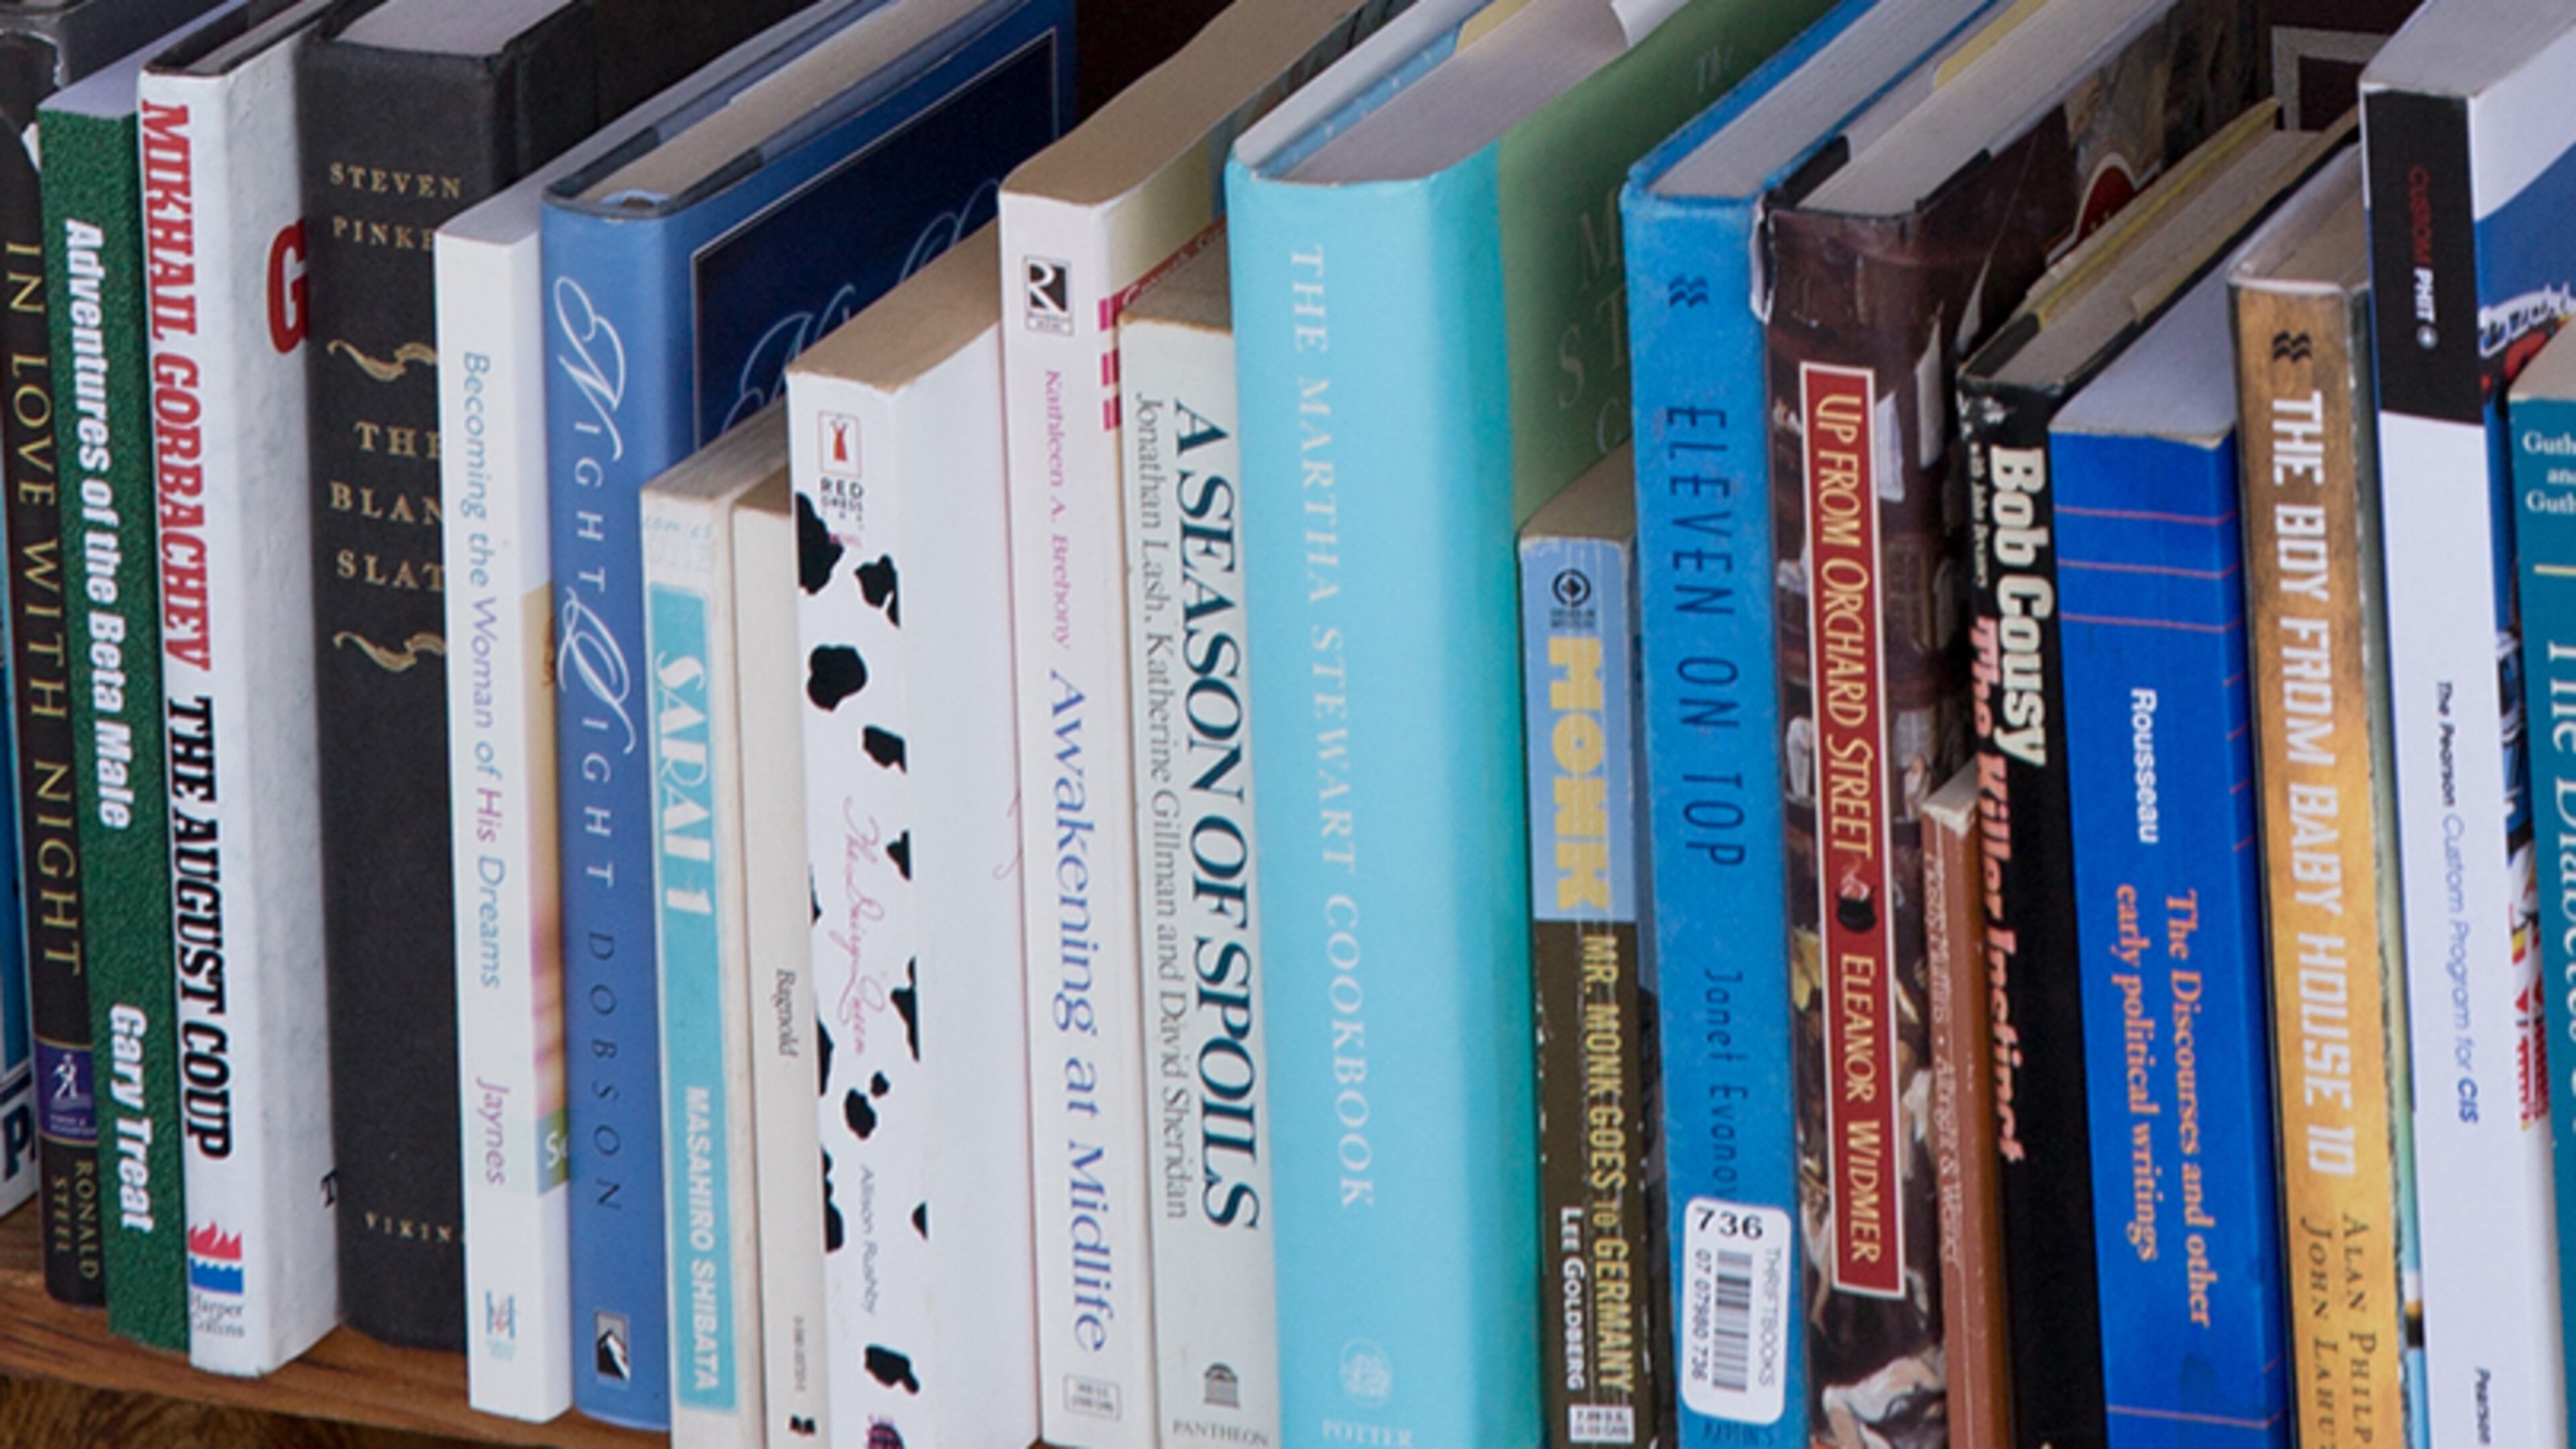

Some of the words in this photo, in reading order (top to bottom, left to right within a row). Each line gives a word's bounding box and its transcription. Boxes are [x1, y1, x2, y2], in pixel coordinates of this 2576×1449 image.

[141, 101, 197, 341] MIKHAIL
[329, 162, 462, 199] STEVEN
[2408, 165, 2434, 264] CUSTOM
[6, 241, 45, 314] IN
[1289, 242, 1328, 354] THE
[2414, 267, 2436, 323] PHIT
[64, 218, 111, 474] Adventures
[11, 354, 56, 508] LOVE
[460, 351, 491, 519] Becoming
[1044, 368, 1067, 490] Kathleen
[1134, 390, 1166, 532] Jonathan
[1174, 398, 1230, 458] A
[1815, 393, 1862, 446] UP
[2271, 389, 2324, 485] THE
[80, 476, 120, 527] of
[152, 352, 213, 672] GORBACHEV
[819, 477, 865, 498] RED
[1046, 499, 1065, 524] A.
[1296, 376, 1340, 605] MARTHA
[1666, 405, 1736, 616] ELEVEN
[1817, 449, 1862, 549] FROM
[1989, 444, 2049, 567] Bob
[83, 527, 123, 603] the
[468, 526, 497, 588] the
[1051, 535, 1073, 651] Brehony
[1140, 540, 1171, 624] Lash,
[2274, 503, 2329, 601] BOY
[21, 537, 67, 718] WITH
[88, 610, 131, 712] Beta
[472, 596, 498, 729] Woman
[1175, 471, 1244, 805] SEASON
[1821, 557, 1869, 727] ORCHARD
[1970, 615, 2000, 739] The
[1993, 574, 2054, 767] Cousy
[1144, 632, 1177, 787] Katherine
[1676, 656, 1741, 729] ON
[2280, 616, 2336, 767] FROM
[2436, 681, 2453, 716] The
[94, 720, 135, 830] Male
[168, 695, 216, 802] THE
[474, 742, 502, 781] of
[655, 651, 711, 863] SARAI
[1309, 623, 1357, 875] STEWART
[1548, 636, 1611, 910] MONK
[1825, 733, 1874, 859] STREET
[2130, 688, 2159, 844] Rousseau
[2438, 722, 2456, 806] Pearson
[34, 759, 81, 975] NIGHT
[476, 786, 503, 843] His
[842, 795, 880, 868] The
[1048, 668, 1099, 1038] Awakening
[1150, 790, 1183, 917] Gillman
[1681, 773, 1746, 867] TOP
[1976, 751, 2011, 926] Killer
[2288, 782, 2343, 916] BABY
[2443, 814, 2467, 914] Custom
[173, 808, 228, 1016] AUGUST
[477, 855, 505, 989] Dreams
[664, 888, 713, 916] 1
[1189, 814, 1249, 931] OF
[2110, 883, 2151, 969] early
[2166, 888, 2198, 961] The
[1155, 923, 1186, 982] and
[1582, 935, 1621, 994] MR.
[2445, 919, 2471, 1032] Program
[110, 1003, 148, 1110] Gary
[588, 931, 622, 1210] DOBSON
[1158, 989, 1189, 1081] David
[1324, 894, 1375, 1208] COOKBOOK
[1584, 1002, 1623, 1099] MONK
[1703, 968, 1747, 1063] Janet
[1840, 953, 1877, 1103] ELEANOR
[1986, 928, 2025, 1163] Instinct
[2110, 971, 2161, 1115] political
[2170, 969, 2202, 1155] Discourses
[2296, 930, 2353, 1110] HOUSE
[2453, 1036, 2474, 1072] for
[182, 1020, 233, 1159] COUP
[476, 1077, 511, 1186] Jaynes
[1065, 1057, 1099, 1118] at
[1193, 936, 1261, 1232] SPOILS
[2456, 1077, 2479, 1123] CIS
[115, 1117, 154, 1232] Treat
[684, 1085, 716, 1251] MASAHIRO
[1162, 1085, 1195, 1220] Sheridan
[1587, 1108, 1627, 1192] GOES
[1845, 1118, 1882, 1265] WIDMER
[2126, 1121, 2165, 1262] writings
[2181, 1162, 2216, 1230] and
[2306, 1124, 2357, 1177] 10
[75, 1159, 99, 1281] RONALD
[364, 1210, 464, 1242] VIKIN
[1068, 1138, 1115, 1352] Midlife
[1560, 1208, 1582, 1252] LEE
[1592, 1198, 1620, 1228] TO
[1693, 1248, 1712, 1276] 07
[1695, 1206, 1764, 1241] 736
[2300, 1216, 2332, 1320] JOHN
[2341, 1213, 2370, 1313] ALAN
[691, 1259, 720, 1392] SHIBATA
[1562, 1257, 1589, 1391] GOLDBERG
[1593, 1238, 1636, 1394] GERMANY
[1758, 1248, 1782, 1389] THRIFTBOOKS
[2186, 1234, 2218, 1328] other
[1690, 1344, 1709, 1382] 736
[2349, 1331, 2378, 1449] PHILP
[1171, 1417, 1271, 1448] PANTHEON
[1322, 1417, 1414, 1448] POTTER
